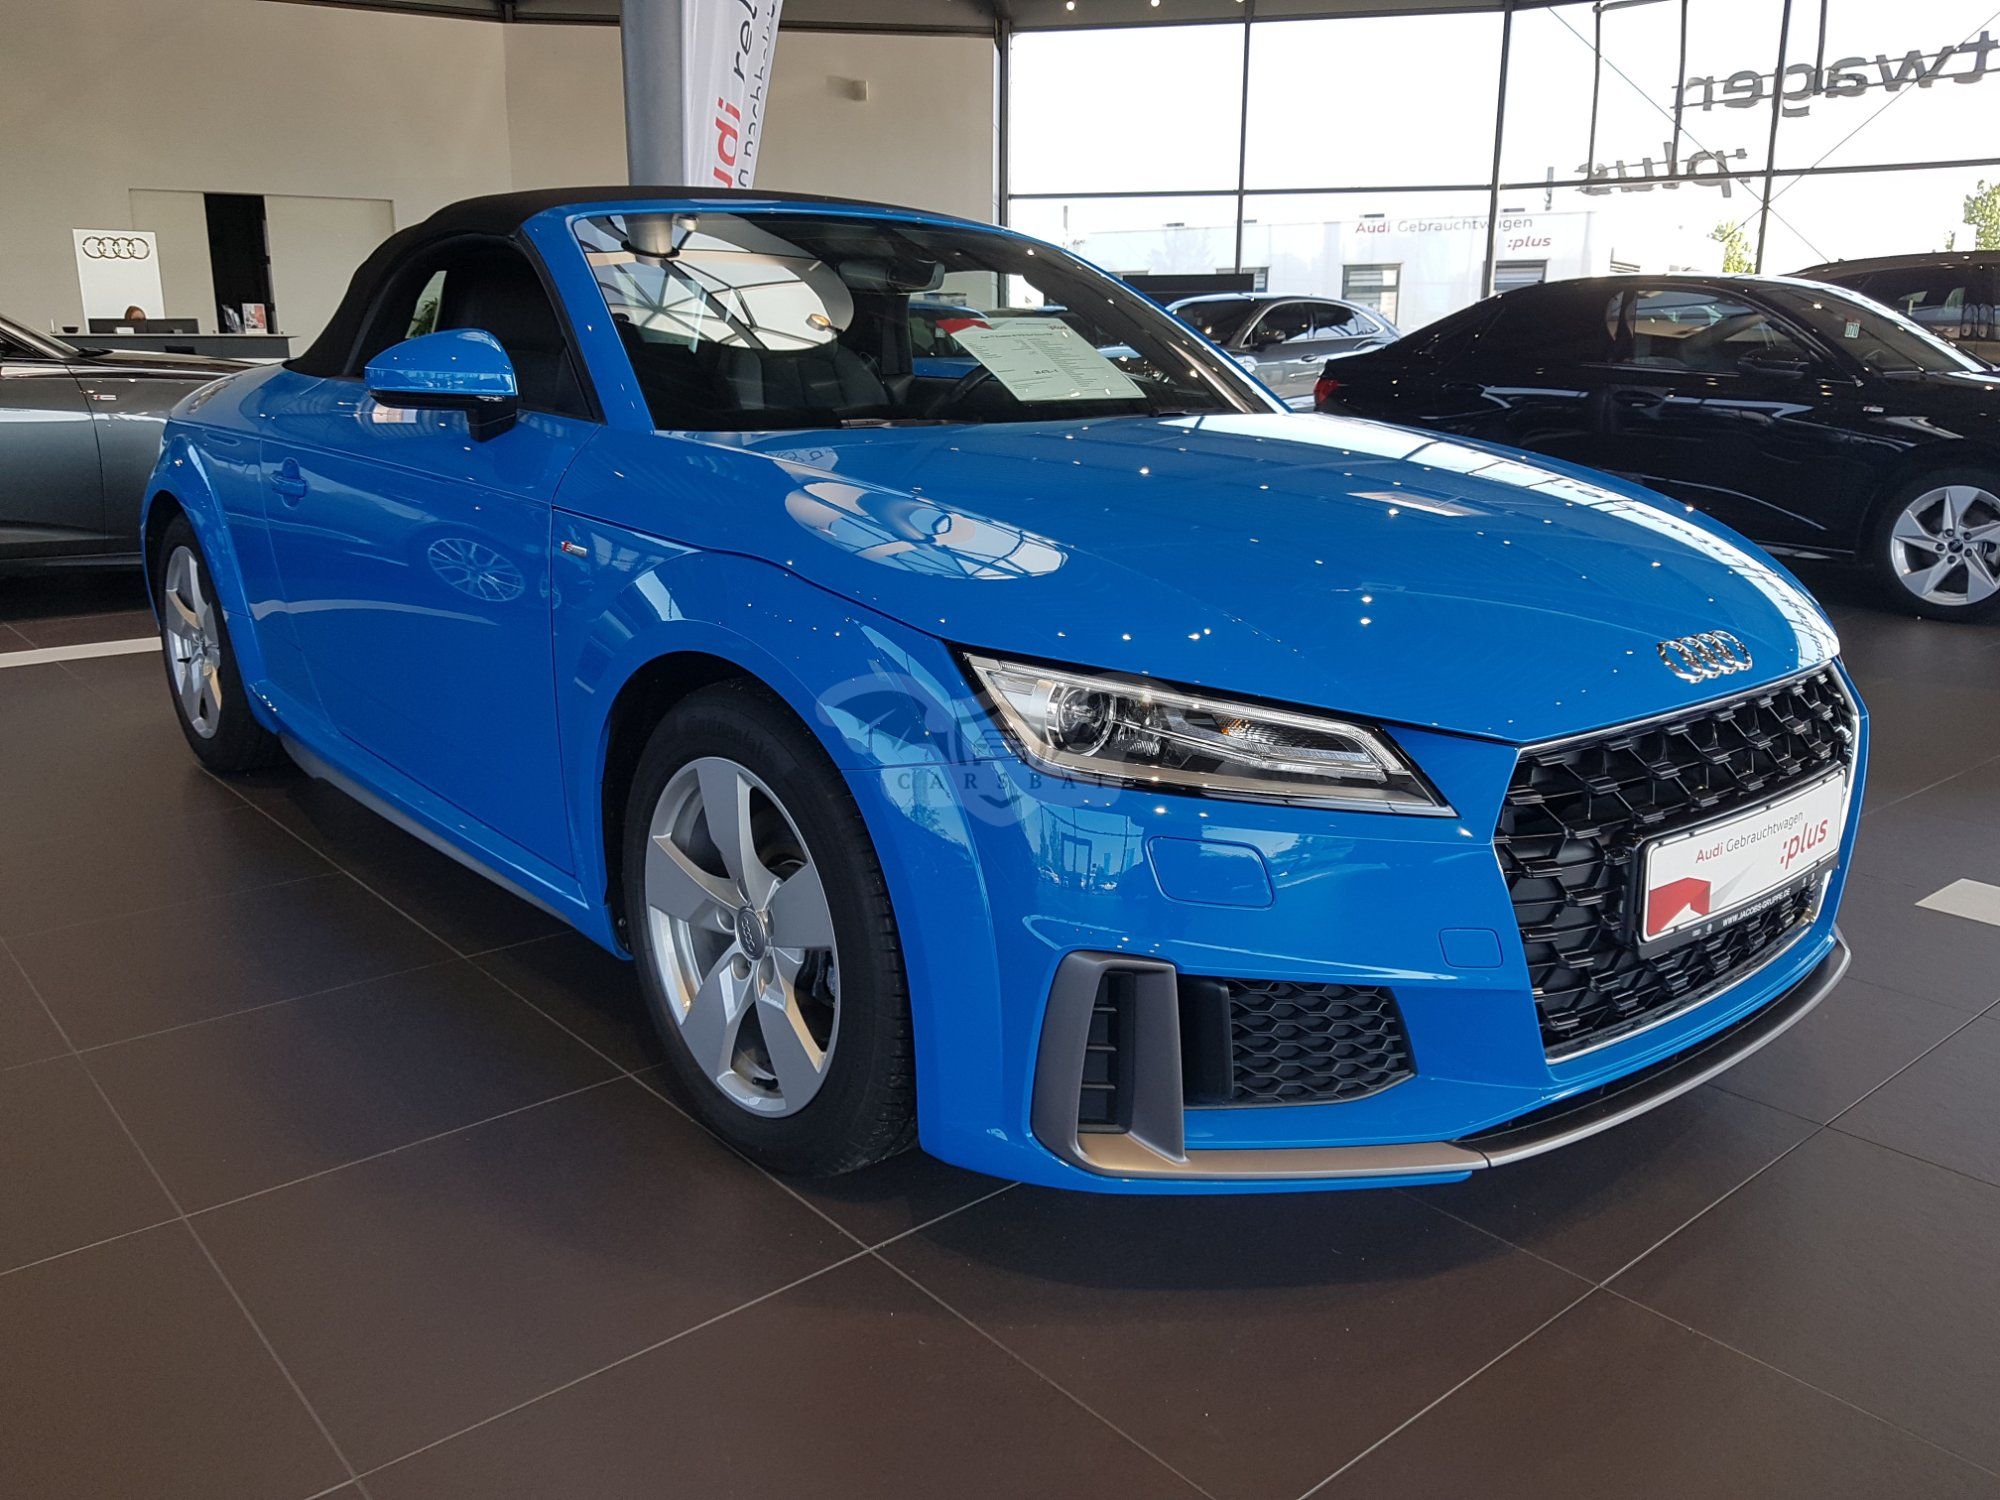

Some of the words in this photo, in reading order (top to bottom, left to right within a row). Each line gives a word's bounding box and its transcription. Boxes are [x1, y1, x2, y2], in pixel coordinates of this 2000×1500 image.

[1355, 221, 1391, 233] Audi
[1397, 218, 1533, 232] Gebrauchtwgen
[1507, 235, 1552, 250] :plus
[1696, 842, 1723, 863] Audi
[1726, 812, 1804, 852] Gebrauchtwagen
[1780, 819, 1828, 869] :plus
